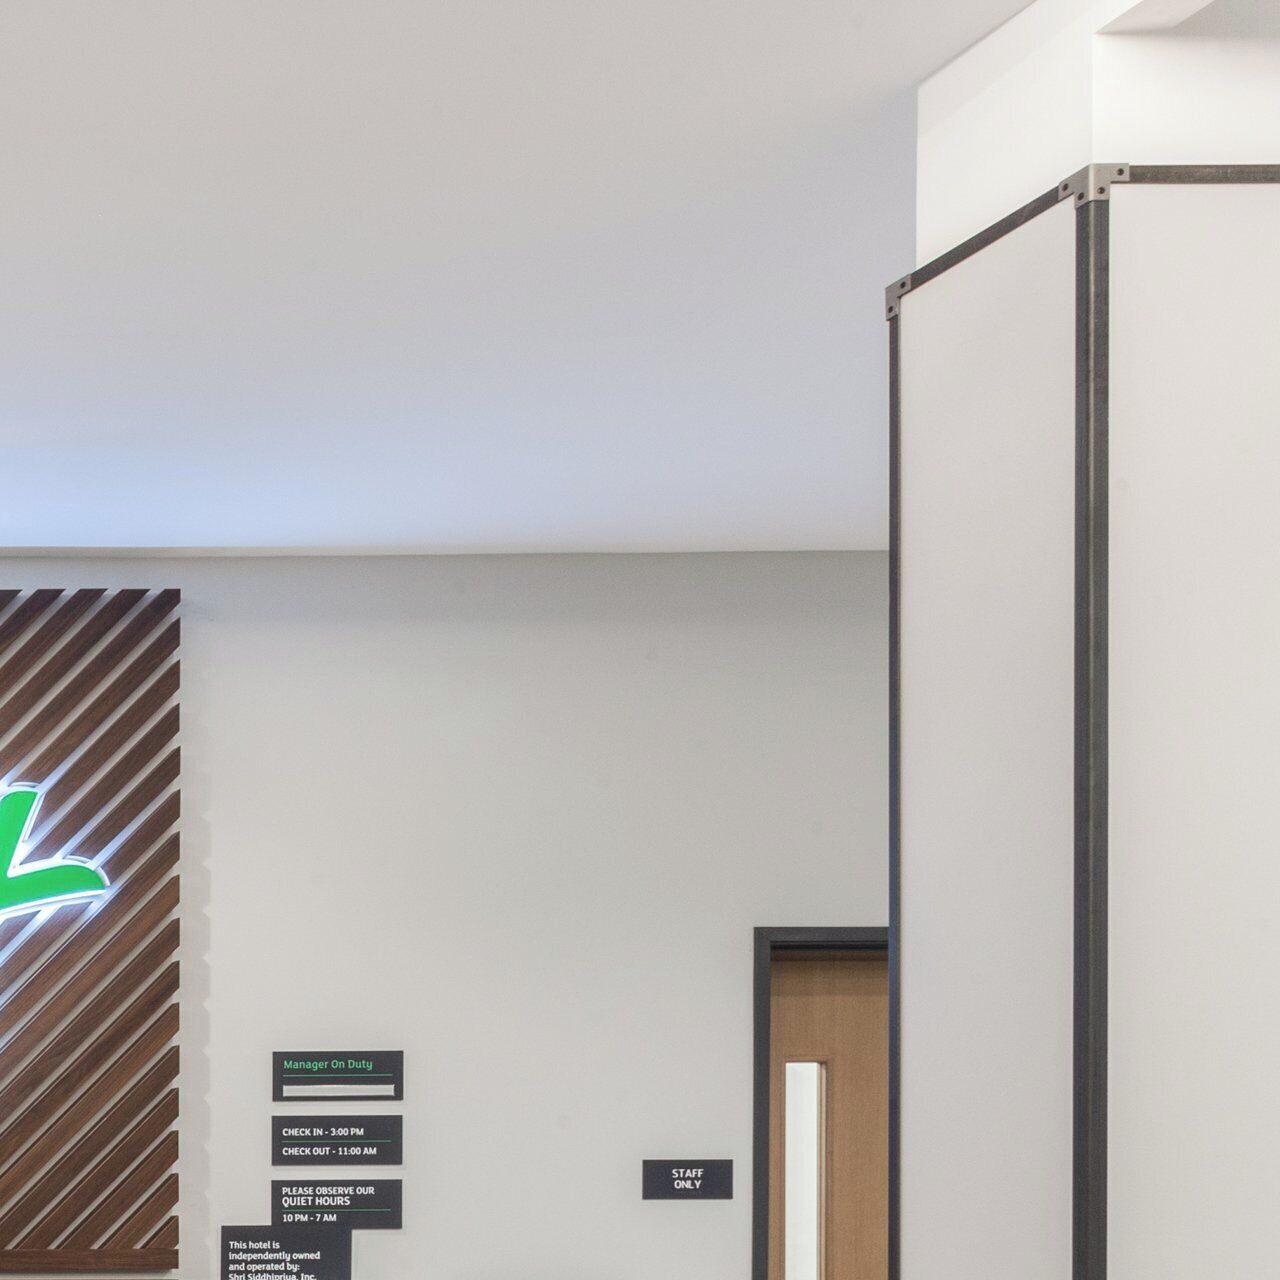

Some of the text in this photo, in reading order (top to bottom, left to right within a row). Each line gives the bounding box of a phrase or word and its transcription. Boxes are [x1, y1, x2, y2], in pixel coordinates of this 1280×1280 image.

[283, 1059, 372, 1071] Manager On Duty
[283, 1128, 311, 1136] CHECK
[313, 1128, 322, 1136] IN
[330, 1128, 348, 1136] 3:00
[282, 1147, 311, 1155] CHECK
[313, 1147, 330, 1155] OUT
[338, 1147, 361, 1155] 11:00
[363, 1147, 376, 1155] AM
[672, 1169, 704, 1178] STAFF
[674, 1180, 701, 1189] ONLY
[282, 1187, 375, 1195] PLEASE OBSERVE OUR
[282, 1197, 350, 1207] QUIET HOURS
[282, 1214, 293, 1222] 10
[295, 1214, 308, 1222] PM
[316, 1214, 320, 1222] 7
[322, 1214, 336, 1222] AM
[229, 1241, 247, 1249] This
[249, 1241, 272, 1249] hotel
[229, 1252, 290, 1261] independently
[247, 1263, 286, 1272] operated
[287, 1263, 300, 1272] by:
[229, 1273, 245, 1280] Shri
[300, 1273, 317, 1280] Inc.
